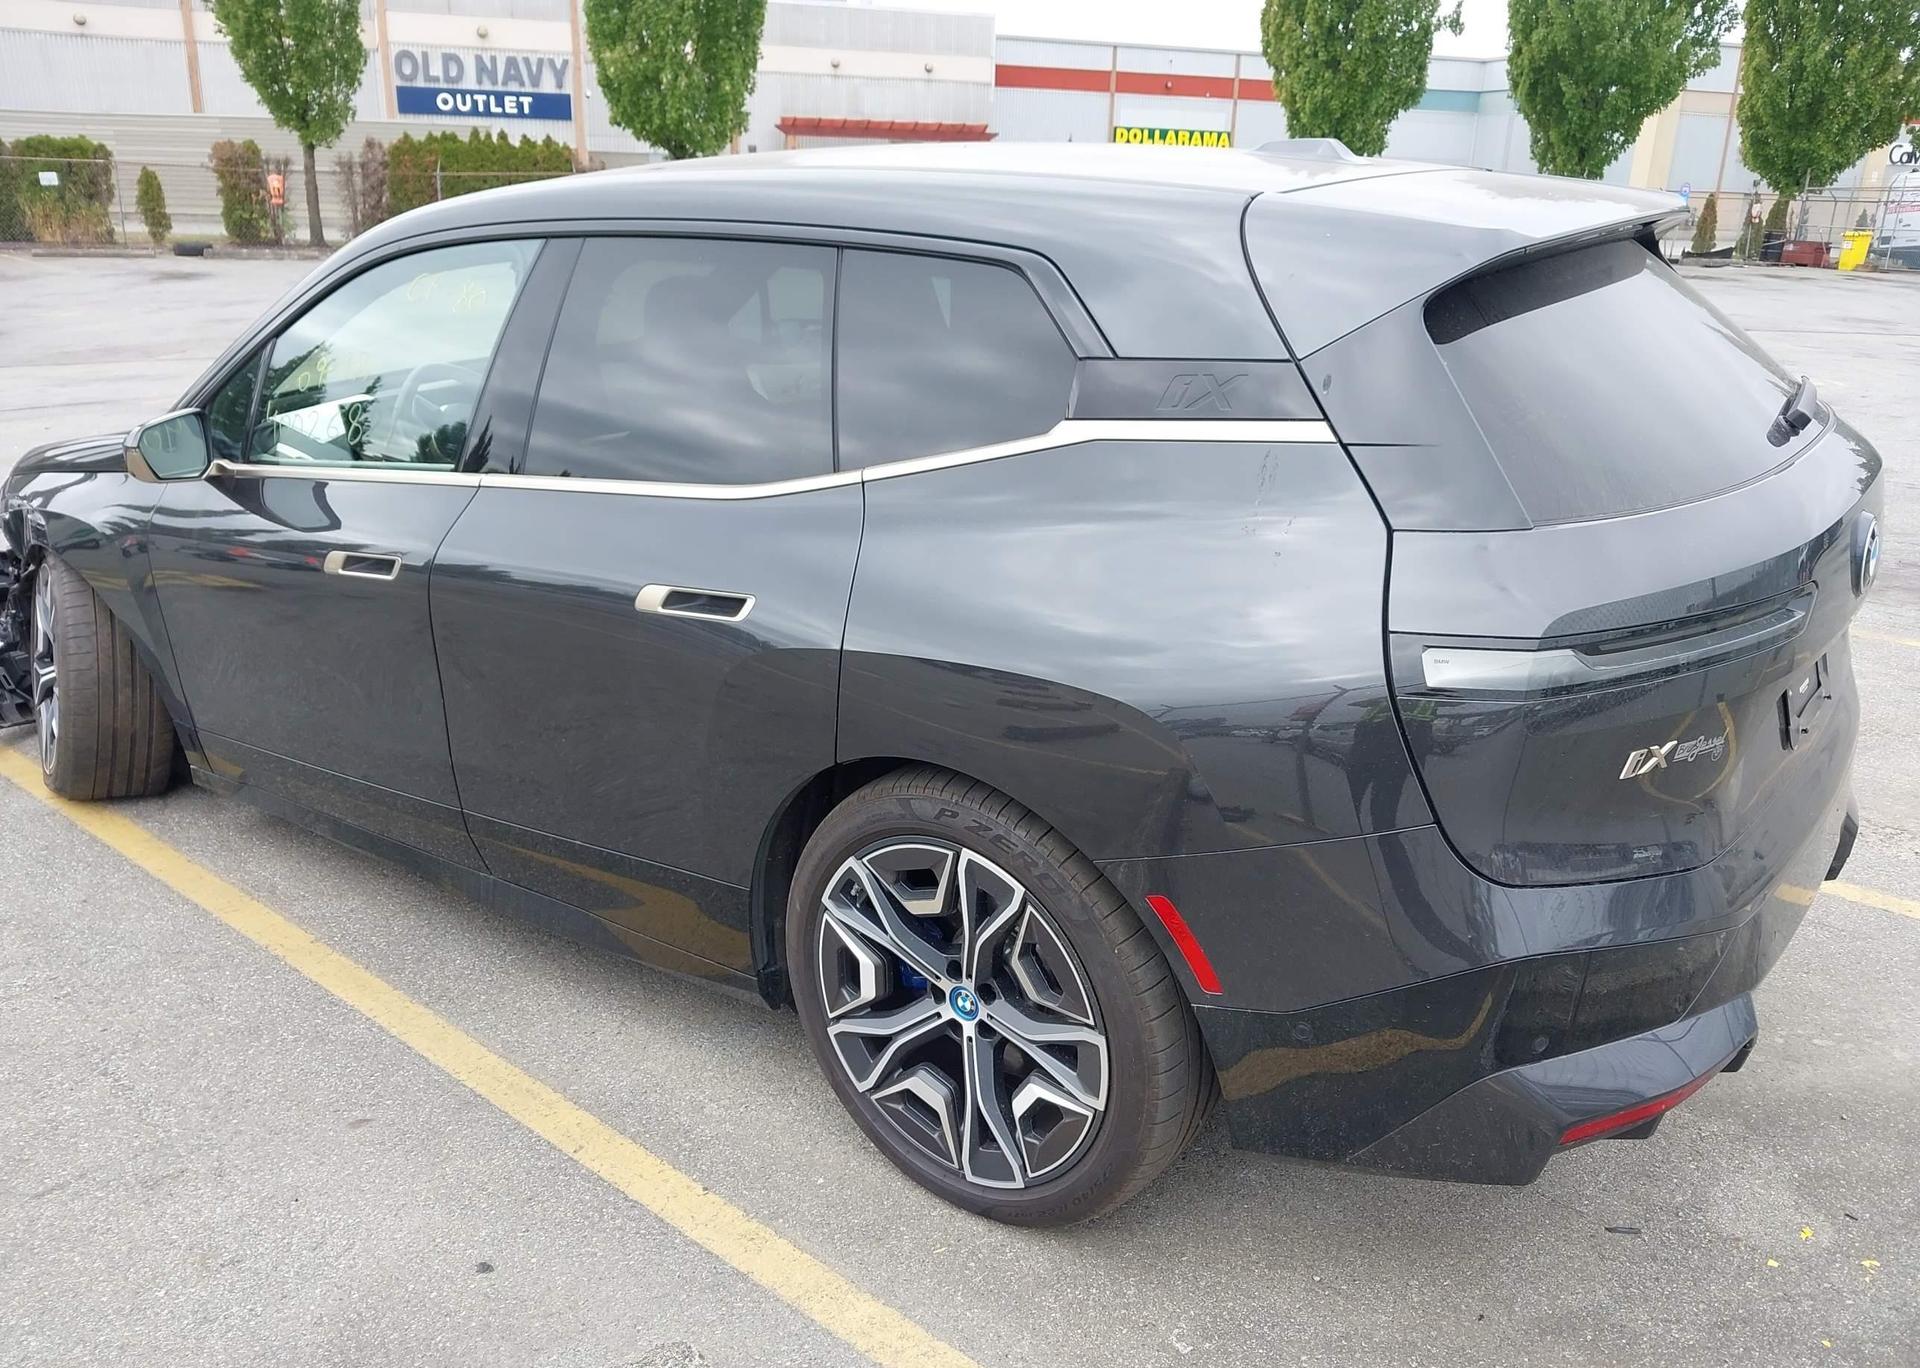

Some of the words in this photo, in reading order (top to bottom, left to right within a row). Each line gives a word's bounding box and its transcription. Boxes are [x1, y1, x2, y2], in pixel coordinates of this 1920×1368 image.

[394, 49, 464, 84] OLD
[475, 54, 569, 89] NAVY
[436, 92, 533, 115] OUTLET
[1115, 127, 1231, 148] DOLLARAMA
[1156, 373, 1249, 411] iX
[1618, 740, 1679, 780] iX
[933, 807, 960, 821] P
[962, 818, 1067, 897] ZERO
